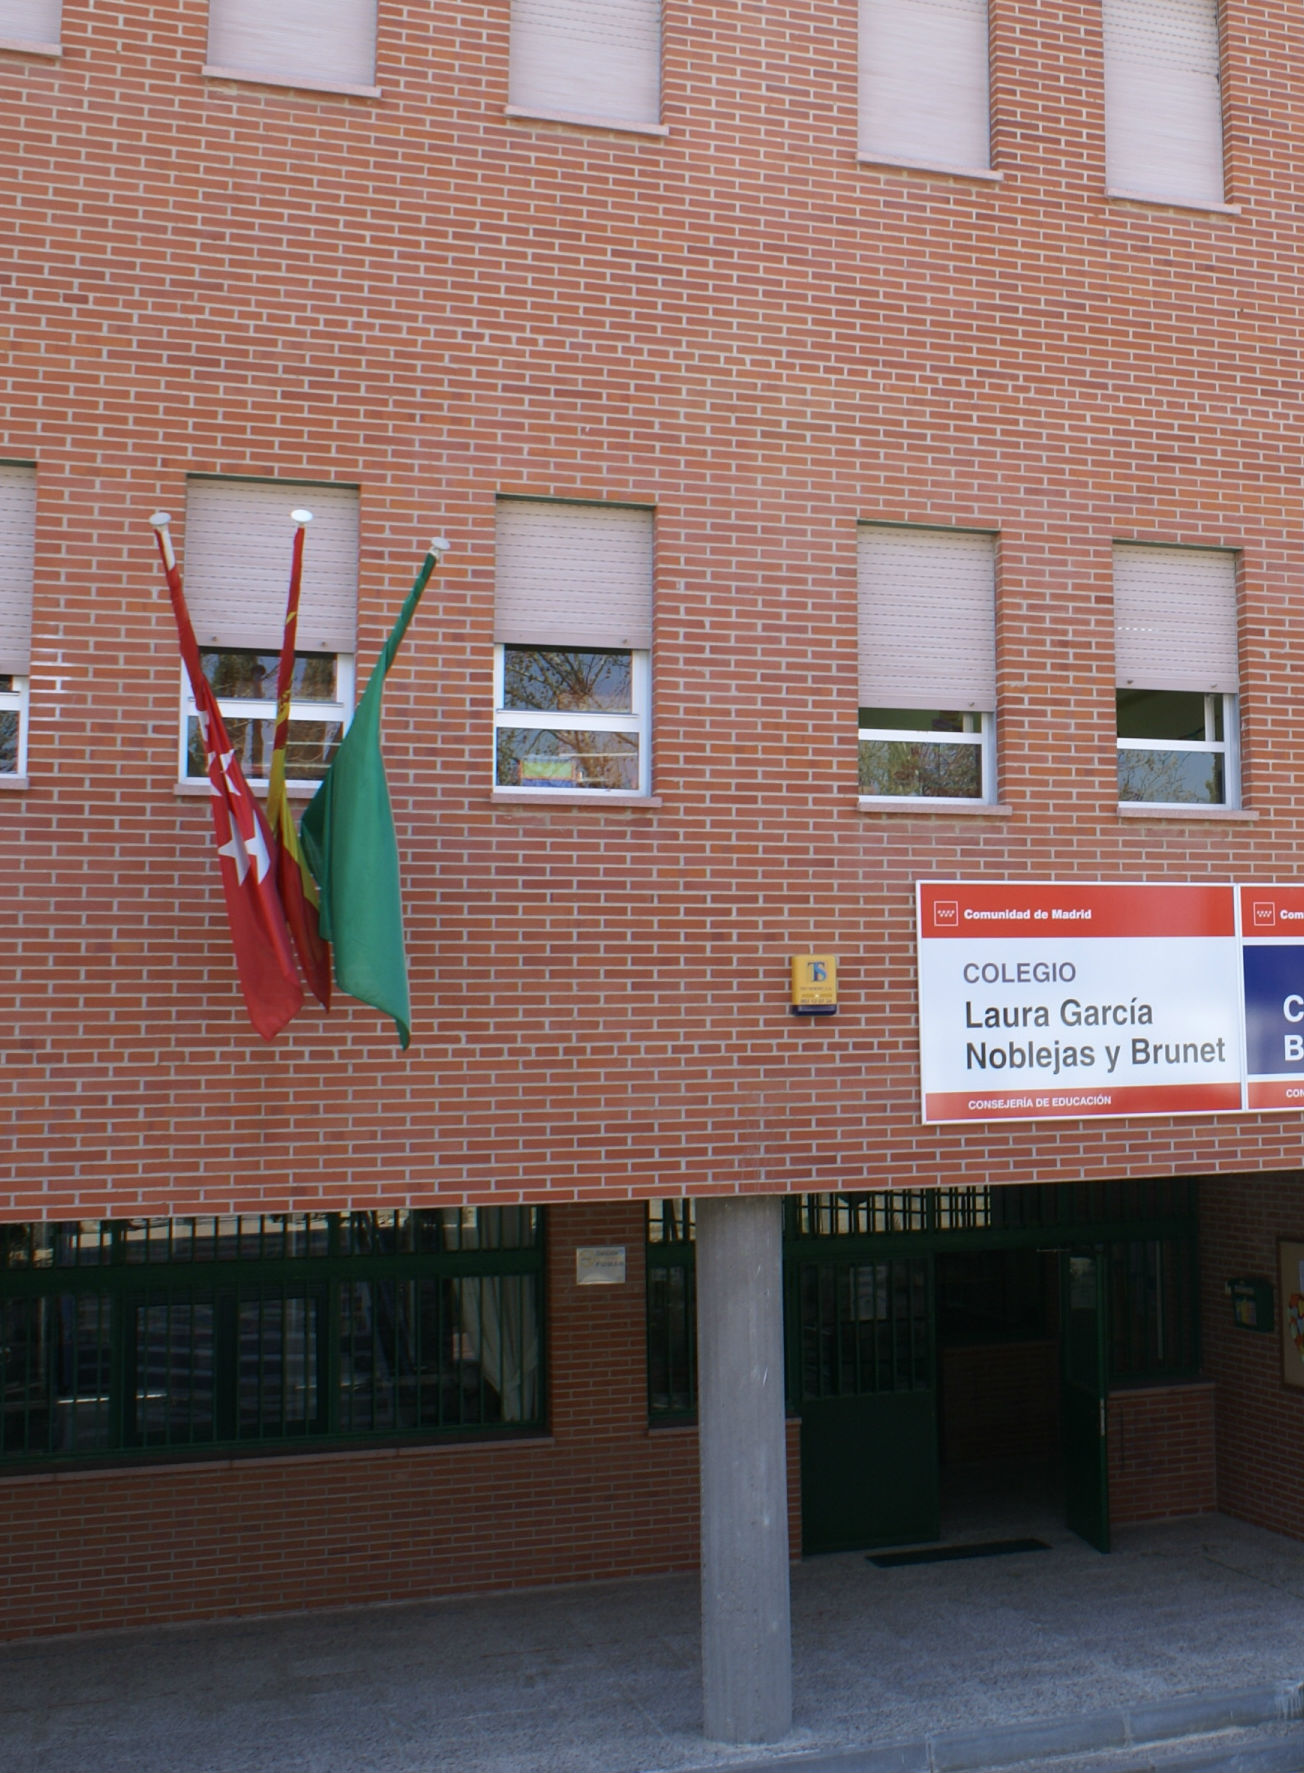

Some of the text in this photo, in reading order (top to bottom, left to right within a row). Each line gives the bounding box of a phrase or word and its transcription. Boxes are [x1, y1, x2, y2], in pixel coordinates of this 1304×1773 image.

[963, 909, 1092, 920] Comunidad de Madrid
[963, 962, 1077, 984] COLEGIO
[965, 997, 1153, 1028] Laura García
[966, 1037, 1226, 1075] Noblejas y Brunet
[968, 1094, 1111, 1110] CONSEJERÍA DE EDUCACIÓN
